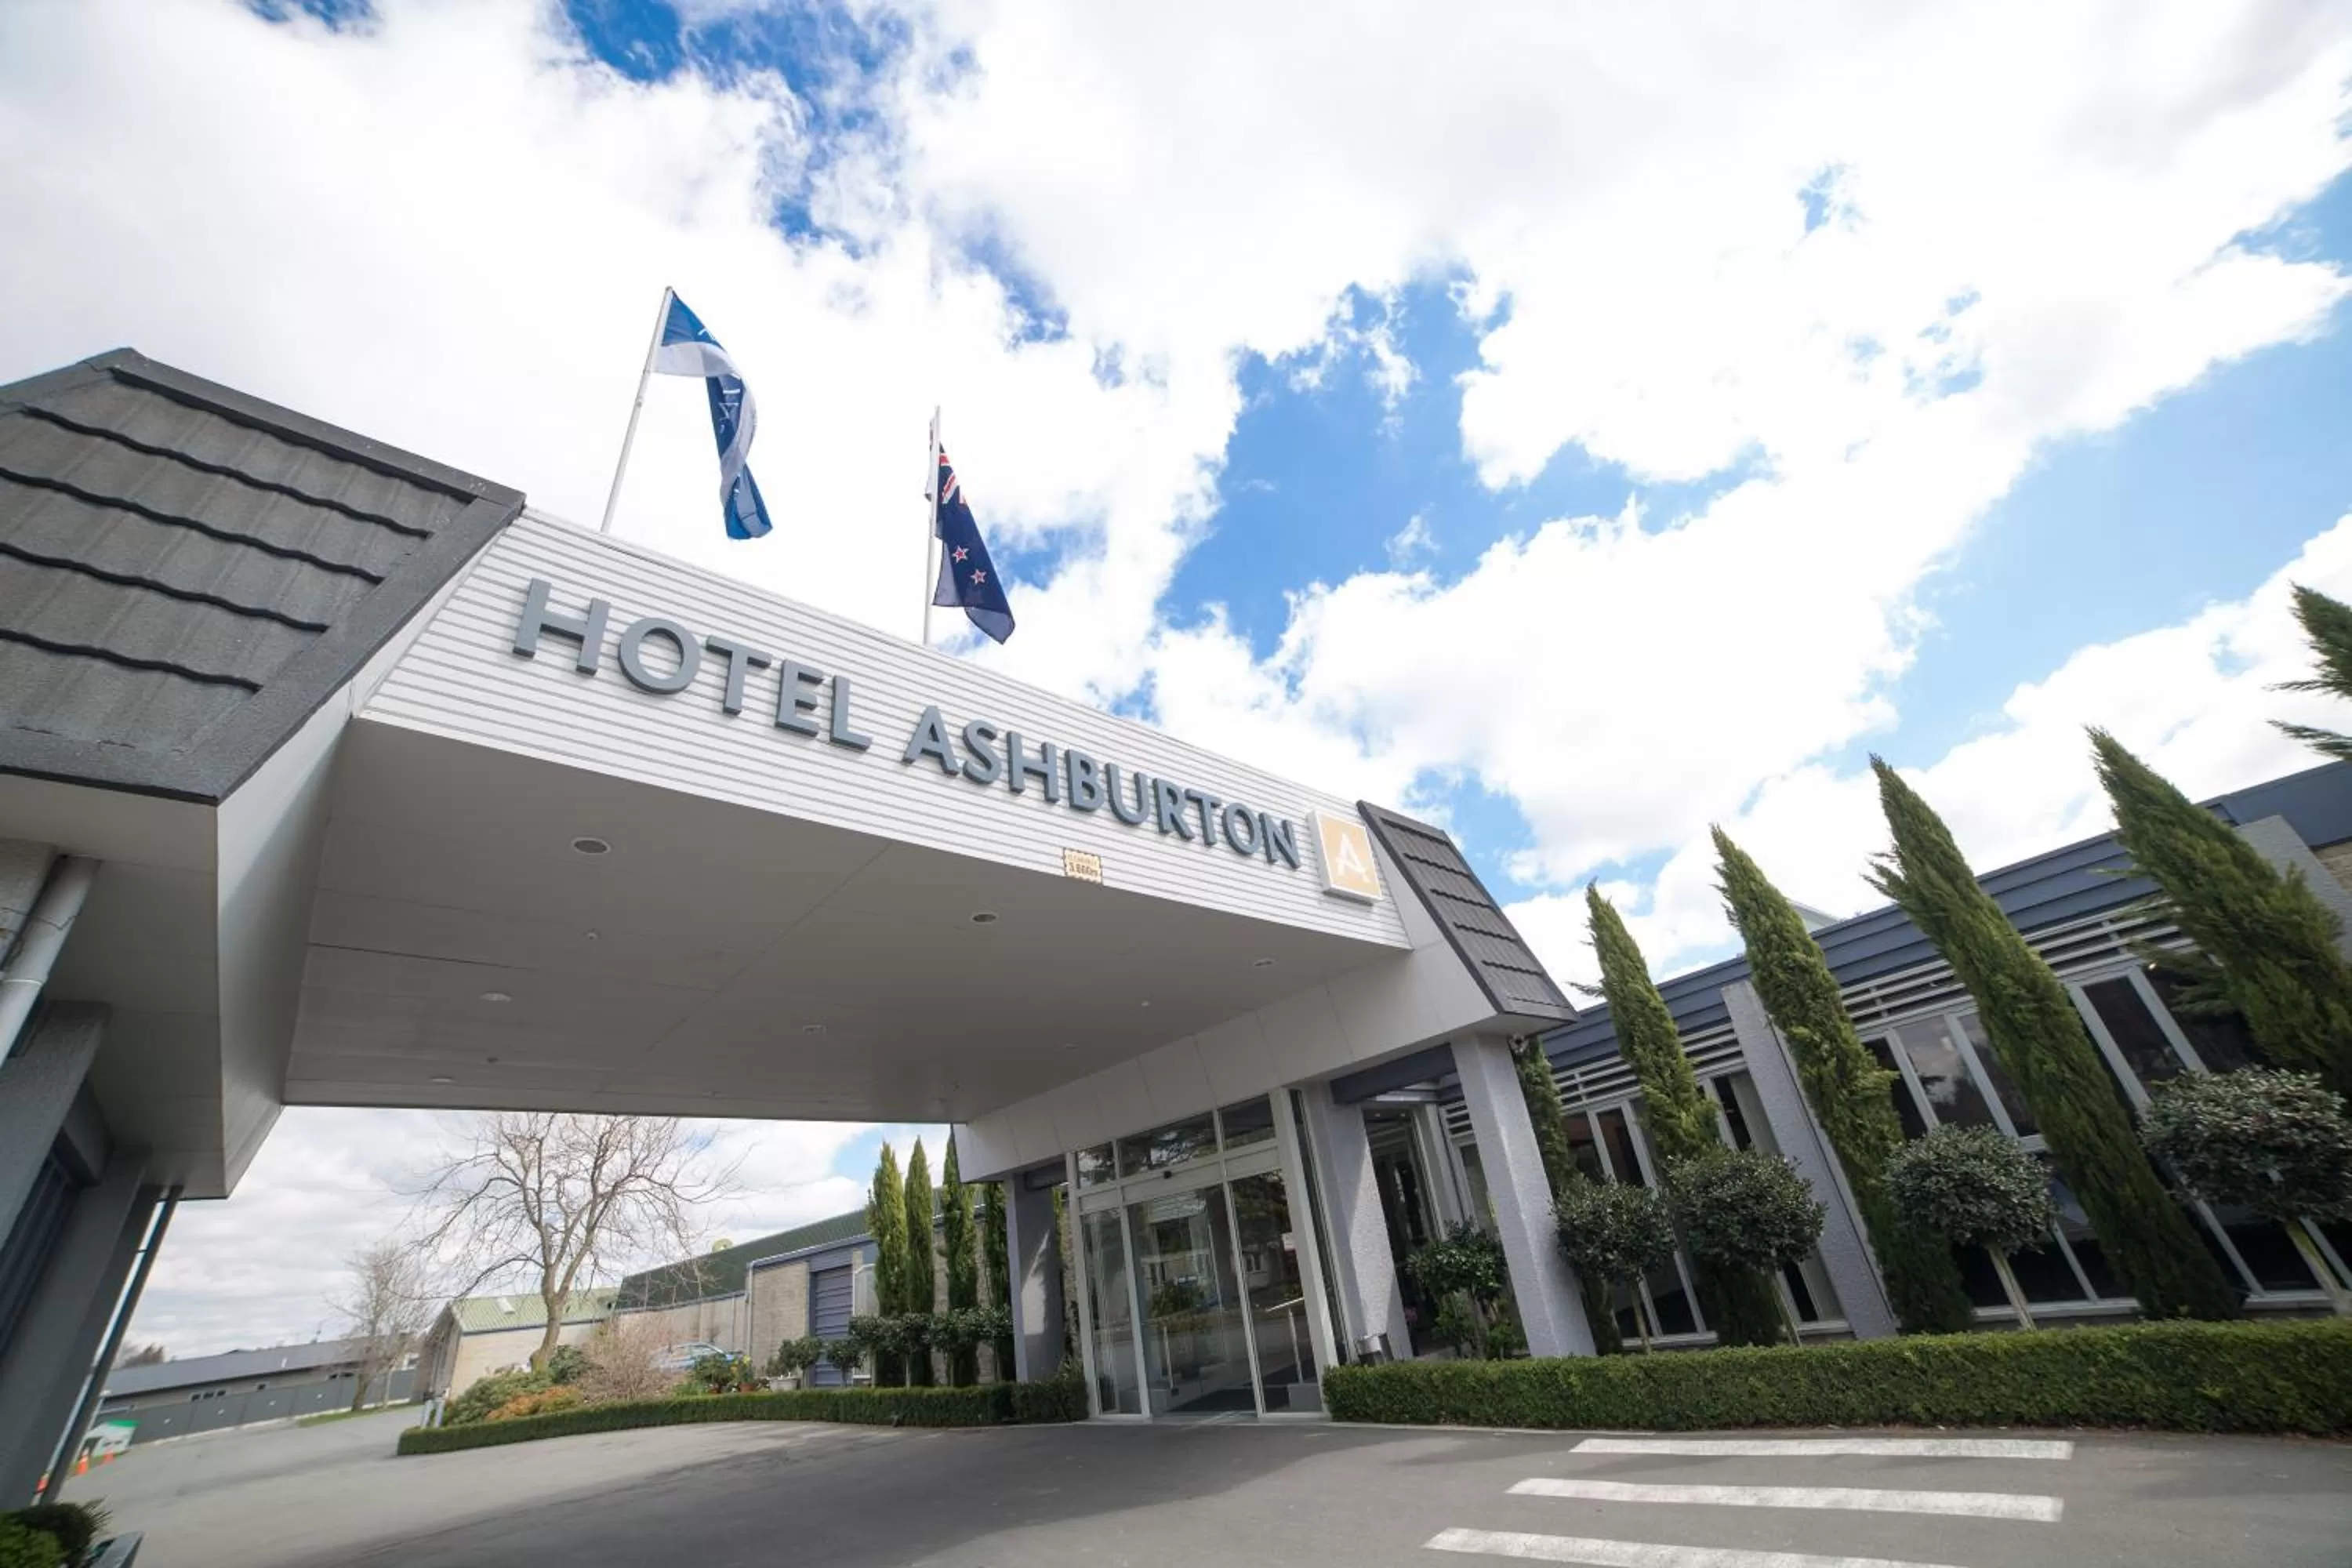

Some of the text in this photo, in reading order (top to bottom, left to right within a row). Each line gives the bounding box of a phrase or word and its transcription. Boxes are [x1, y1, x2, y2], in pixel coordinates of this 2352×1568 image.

[513, 577, 1301, 870] HOTEL ASHBURTON
[1336, 833, 1371, 884] A
